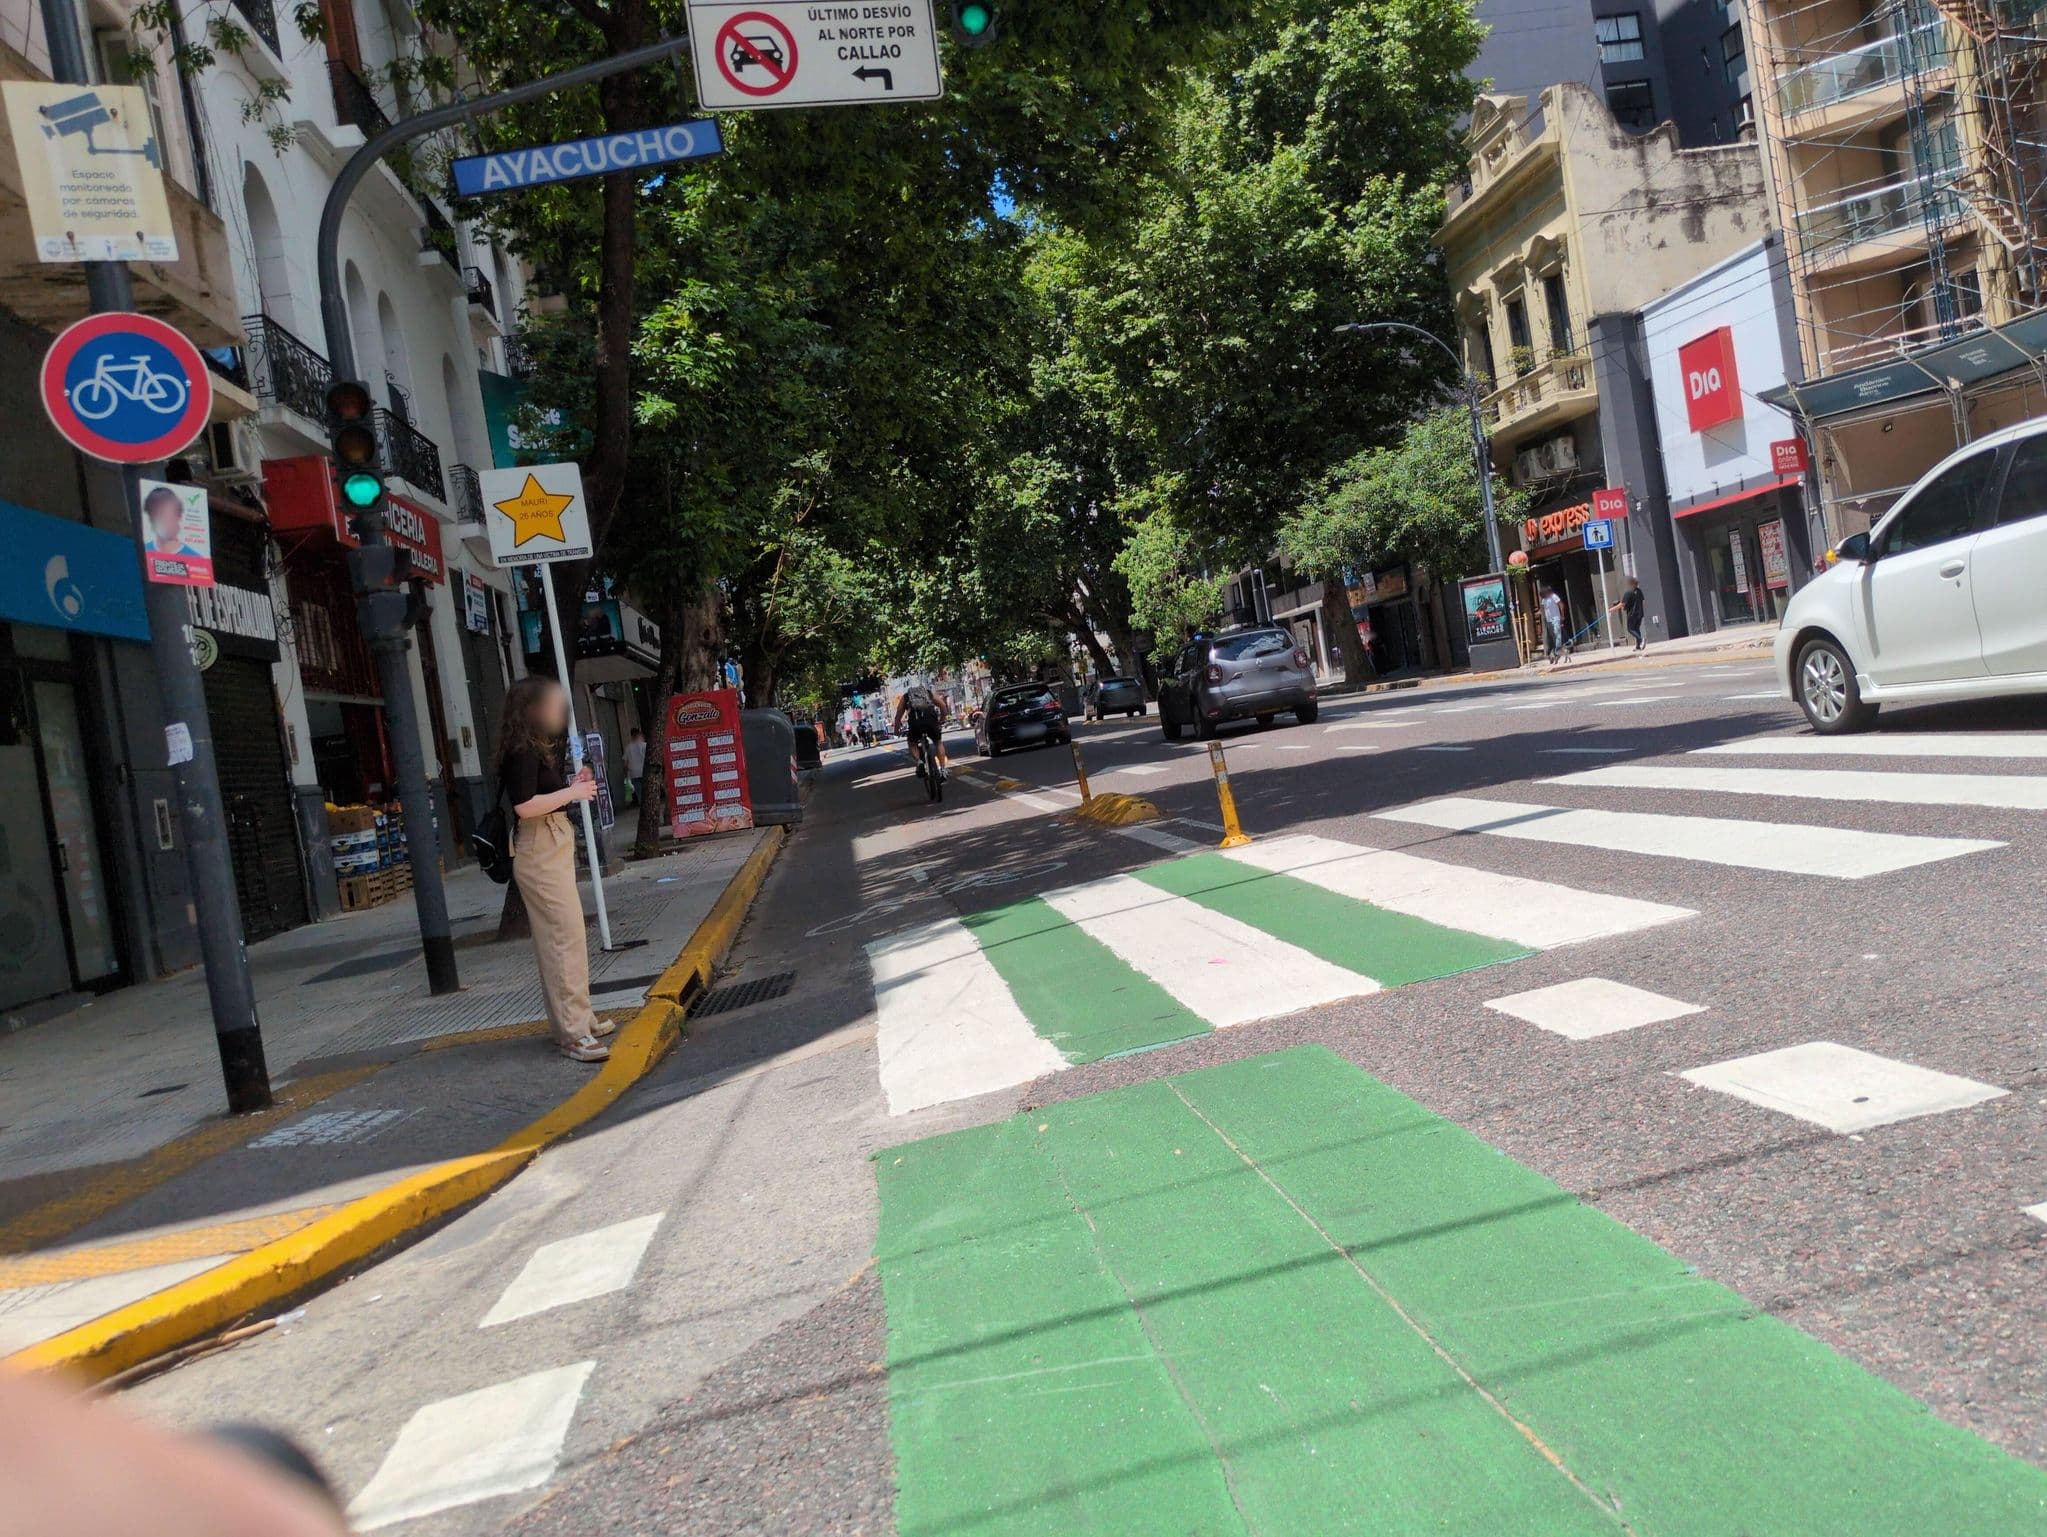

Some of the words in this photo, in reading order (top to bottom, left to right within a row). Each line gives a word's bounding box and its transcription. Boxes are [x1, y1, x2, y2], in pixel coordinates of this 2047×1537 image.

[808, 7, 858, 21] ÚLTIMO
[863, 5, 912, 20] DESVÍO
[818, 28, 836, 41] AL
[839, 27, 885, 40] NORTE
[888, 25, 915, 38] POR
[837, 44, 902, 61] CALLAO
[483, 126, 695, 190] AYACUCHO
[71, 170, 115, 181] Espacio
[59, 184, 132, 193] monitoreado
[62, 198, 80, 207] por
[63, 209, 78, 218] de
[520, 498, 548, 507] MAURI
[1541, 502, 1590, 537] express
[678, 710, 720, 725] Gonzalo
